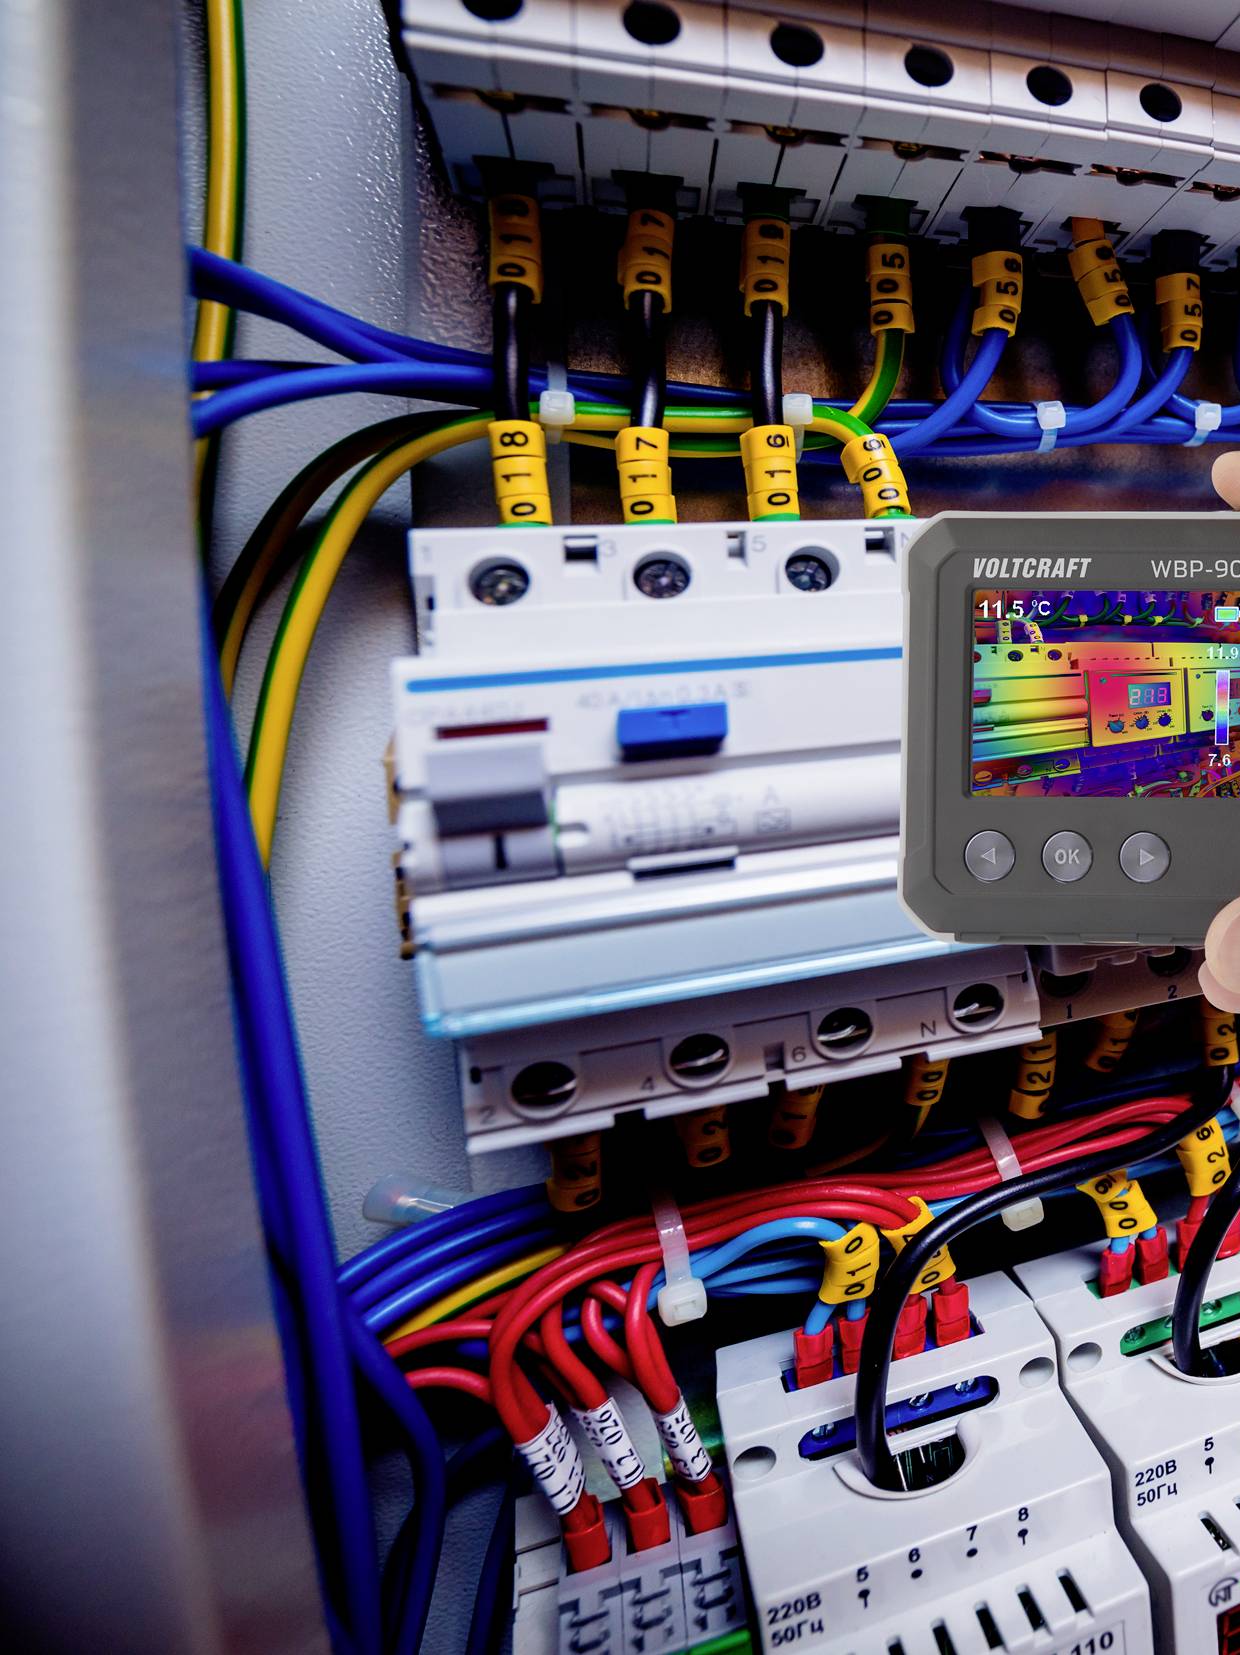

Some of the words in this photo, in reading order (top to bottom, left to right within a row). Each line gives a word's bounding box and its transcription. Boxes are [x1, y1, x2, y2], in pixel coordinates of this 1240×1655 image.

[872, 252, 906, 326] 005
[1180, 277, 1202, 342] 057
[500, 430, 538, 517] 018
[629, 437, 660, 516] 017
[765, 433, 791, 507] 016
[862, 438, 902, 502] 006
[751, 535, 767, 552] 5
[972, 557, 1092, 578] VOLTCRAFT
[978, 600, 1025, 619] 11.5
[1206, 646, 1239, 660] 11.9
[1207, 754, 1232, 767] 7.6
[1054, 848, 1080, 865] OK
[1167, 985, 1178, 999] 2
[1066, 1003, 1073, 1019] 1
[920, 1021, 937, 1038] N
[792, 1046, 806, 1062] 6
[1195, 1125, 1227, 1185] 026
[844, 1235, 873, 1296] 010
[598, 1409, 624, 1446] 026
[1204, 1437, 1214, 1451] 5
[1134, 1459, 1178, 1487] 220В
[1136, 1482, 1179, 1507] 50Гц
[856, 1566, 869, 1582] 5
[908, 1547, 921, 1563] 6
[965, 1525, 978, 1542] 7
[1017, 1507, 1029, 1522] 8
[766, 1591, 823, 1625] 220В
[770, 1620, 824, 1649] 50Гц
